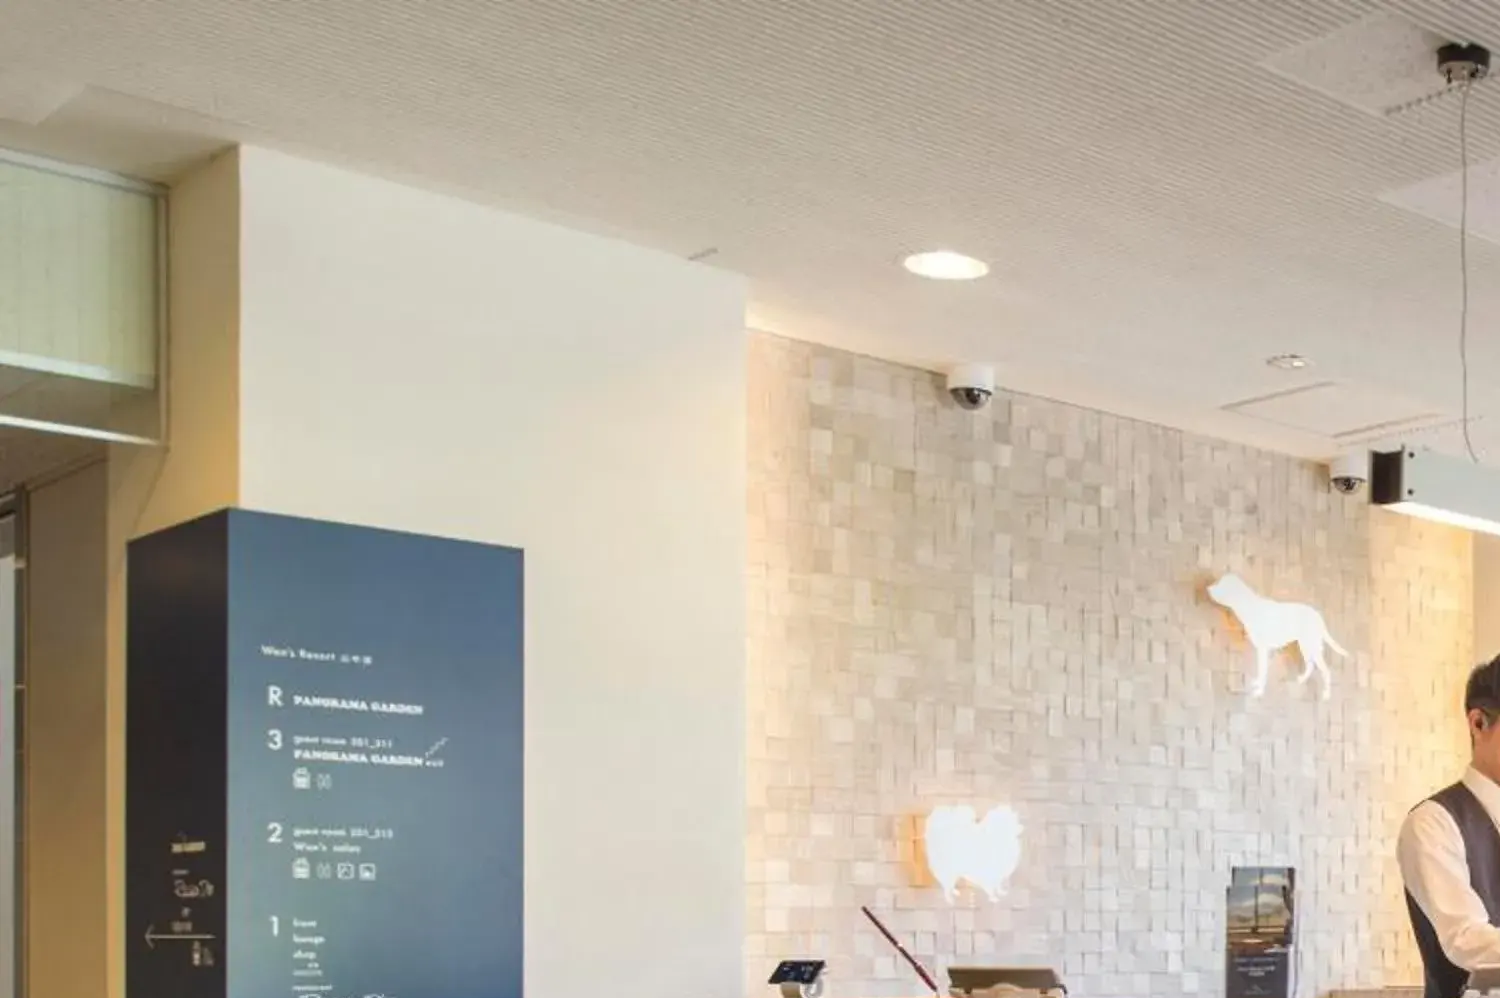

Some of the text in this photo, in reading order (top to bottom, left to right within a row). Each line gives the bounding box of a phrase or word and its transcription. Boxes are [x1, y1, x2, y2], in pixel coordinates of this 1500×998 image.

[267, 685, 423, 715] R PANORAMA GARDEN
[267, 729, 283, 750] 3
[294, 748, 368, 764] PANORAMA
[370, 754, 424, 767] GARDEN
[267, 822, 283, 842] 2
[269, 915, 279, 937] 1
